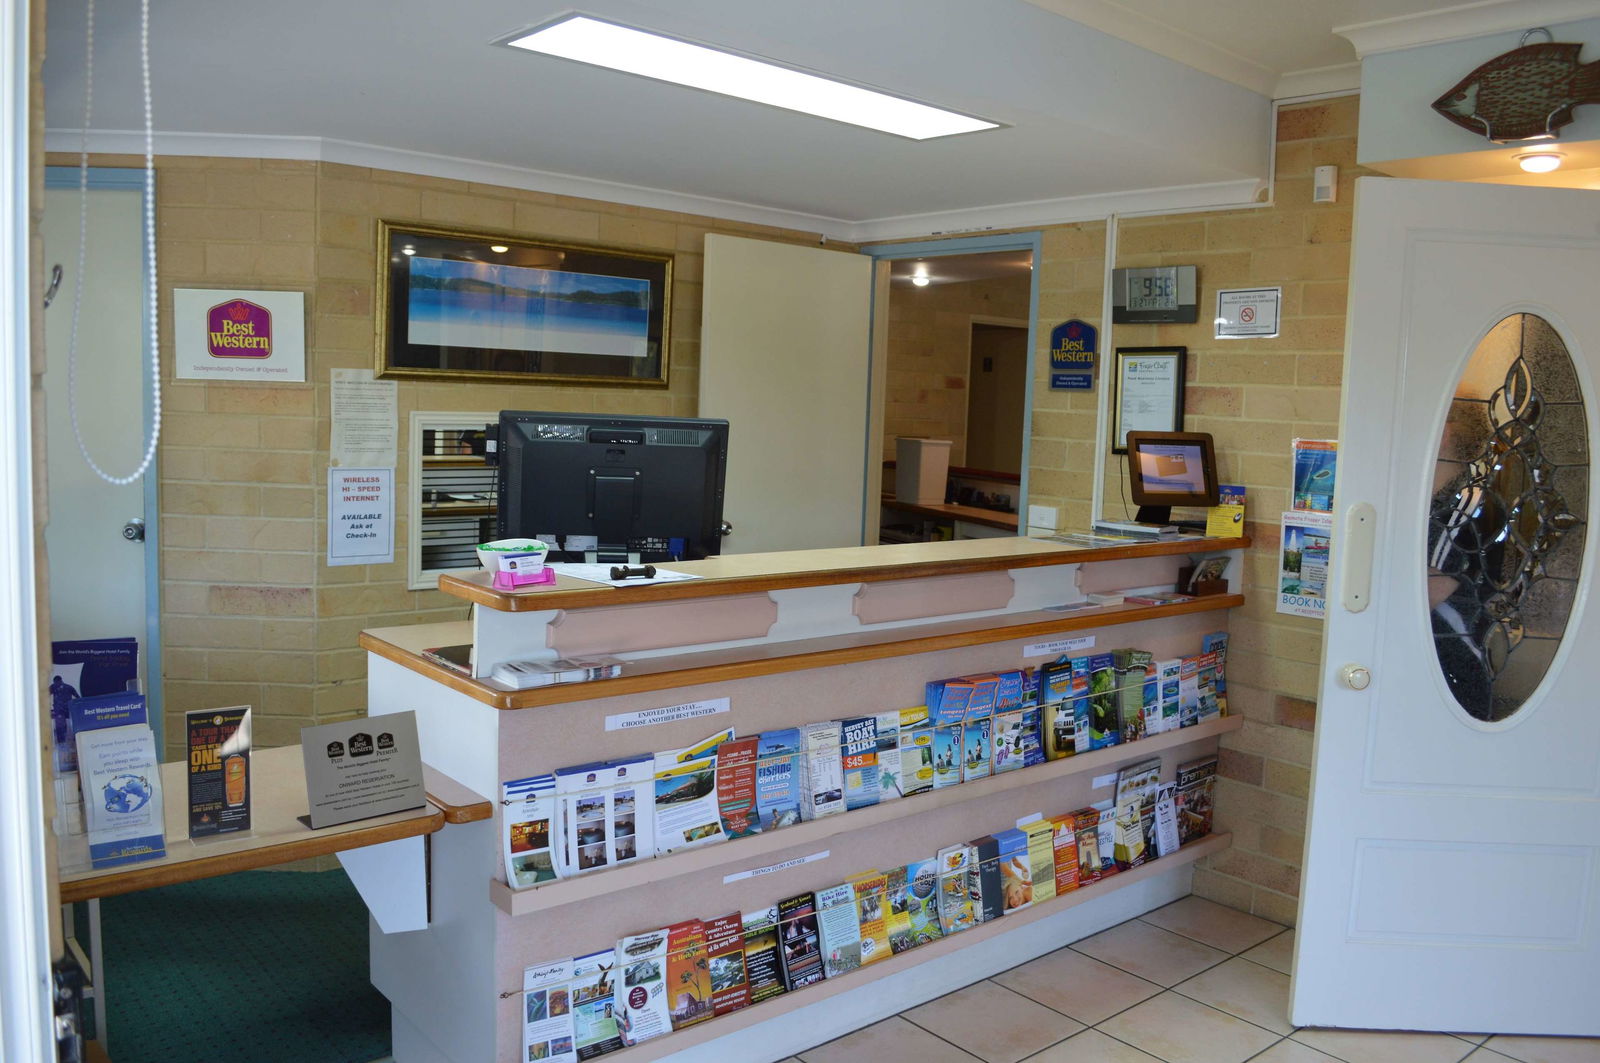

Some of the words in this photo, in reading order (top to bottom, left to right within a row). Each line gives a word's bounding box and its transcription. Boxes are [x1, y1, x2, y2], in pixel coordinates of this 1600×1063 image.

[222, 320, 255, 336] Best
[210, 332, 270, 350] Western
[1062, 338, 1084, 351] Best
[1053, 349, 1093, 362] Western
[1282, 595, 1311, 608] BOOK
[621, 719, 646, 728] CHOOSE
[648, 715, 674, 724] ANOTHER
[691, 708, 716, 718] WESTERN
[638, 707, 665, 718] ENJOYED
[666, 705, 681, 715] YOUR
[845, 721, 865, 733] HERVEY
[865, 718, 875, 727] BAY
[846, 725, 875, 744] BOAT
[350, 745, 373, 754] Western
[847, 736, 877, 755] HIRE
[192, 748, 222, 765] ONE
[847, 756, 863, 768] $45
[759, 763, 792, 777] FISHING
[339, 780, 361, 789] ONWARD
[362, 774, 395, 784] RESERVATION
[836, 890, 848, 898] Hire
